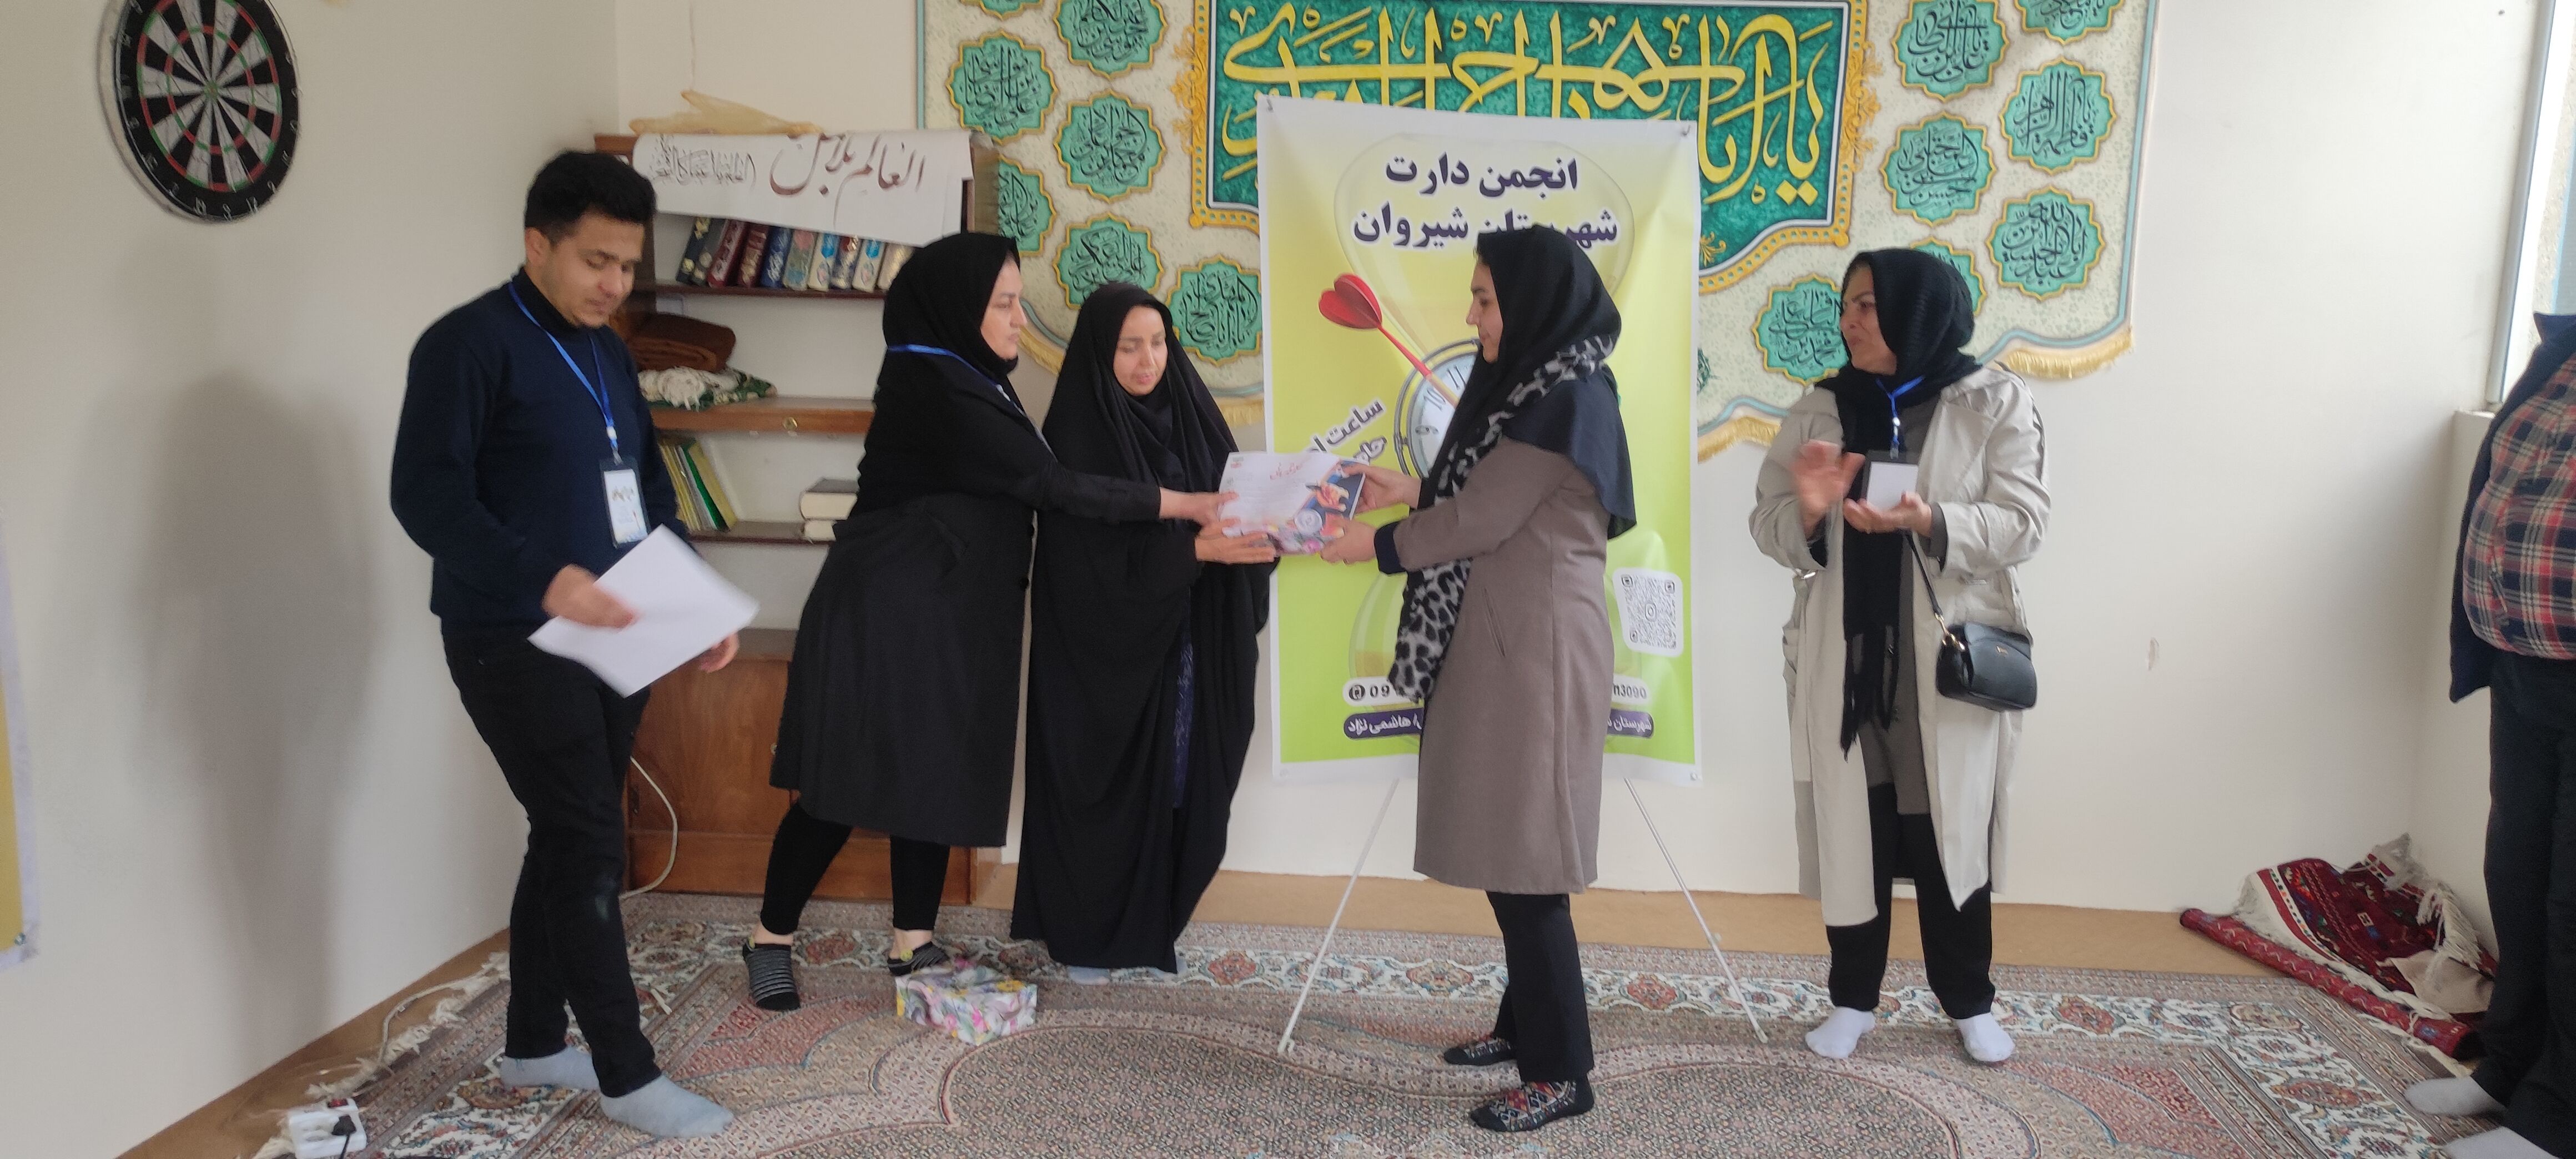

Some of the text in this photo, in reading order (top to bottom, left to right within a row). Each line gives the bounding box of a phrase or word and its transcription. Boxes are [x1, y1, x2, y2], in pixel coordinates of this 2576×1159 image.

[1386, 152, 1578, 198] انجمن دارت
[1354, 201, 1618, 249] شهرتا شیروان
[1326, 401, 1383, 445] ساعت
[1347, 718, 1368, 736] نژاد
[1368, 714, 1412, 735] هاشمی
